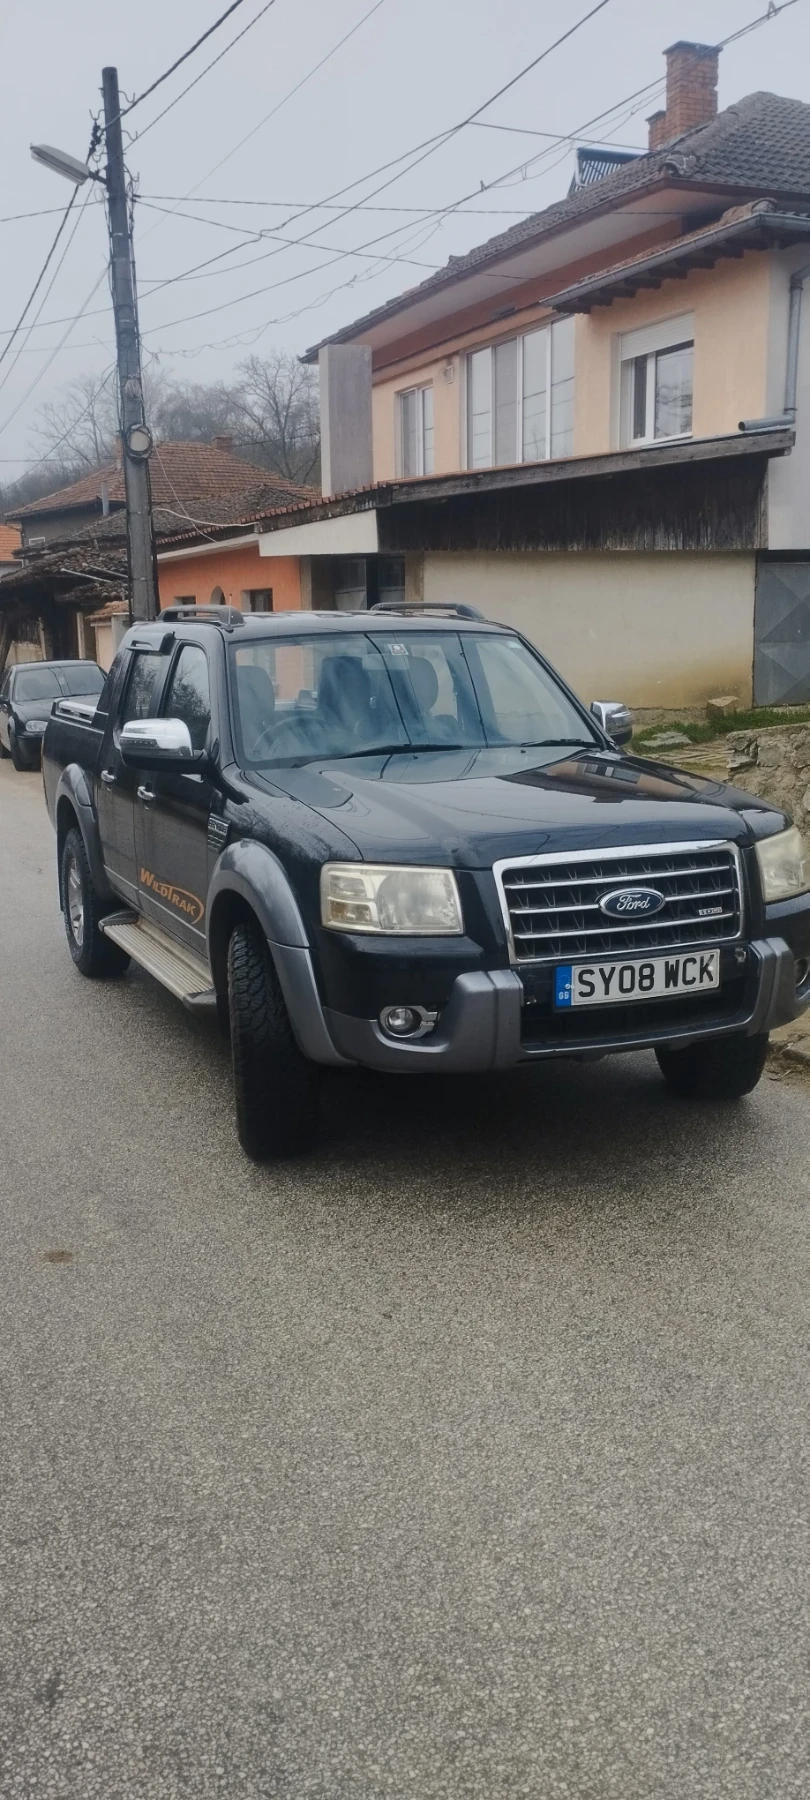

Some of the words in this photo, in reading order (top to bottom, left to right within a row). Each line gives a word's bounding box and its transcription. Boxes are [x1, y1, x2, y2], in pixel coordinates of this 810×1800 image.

[616, 894, 651, 911] Ford
[578, 963, 655, 998] SY08
[664, 954, 715, 988] WCK
[558, 991, 570, 1000] GB
